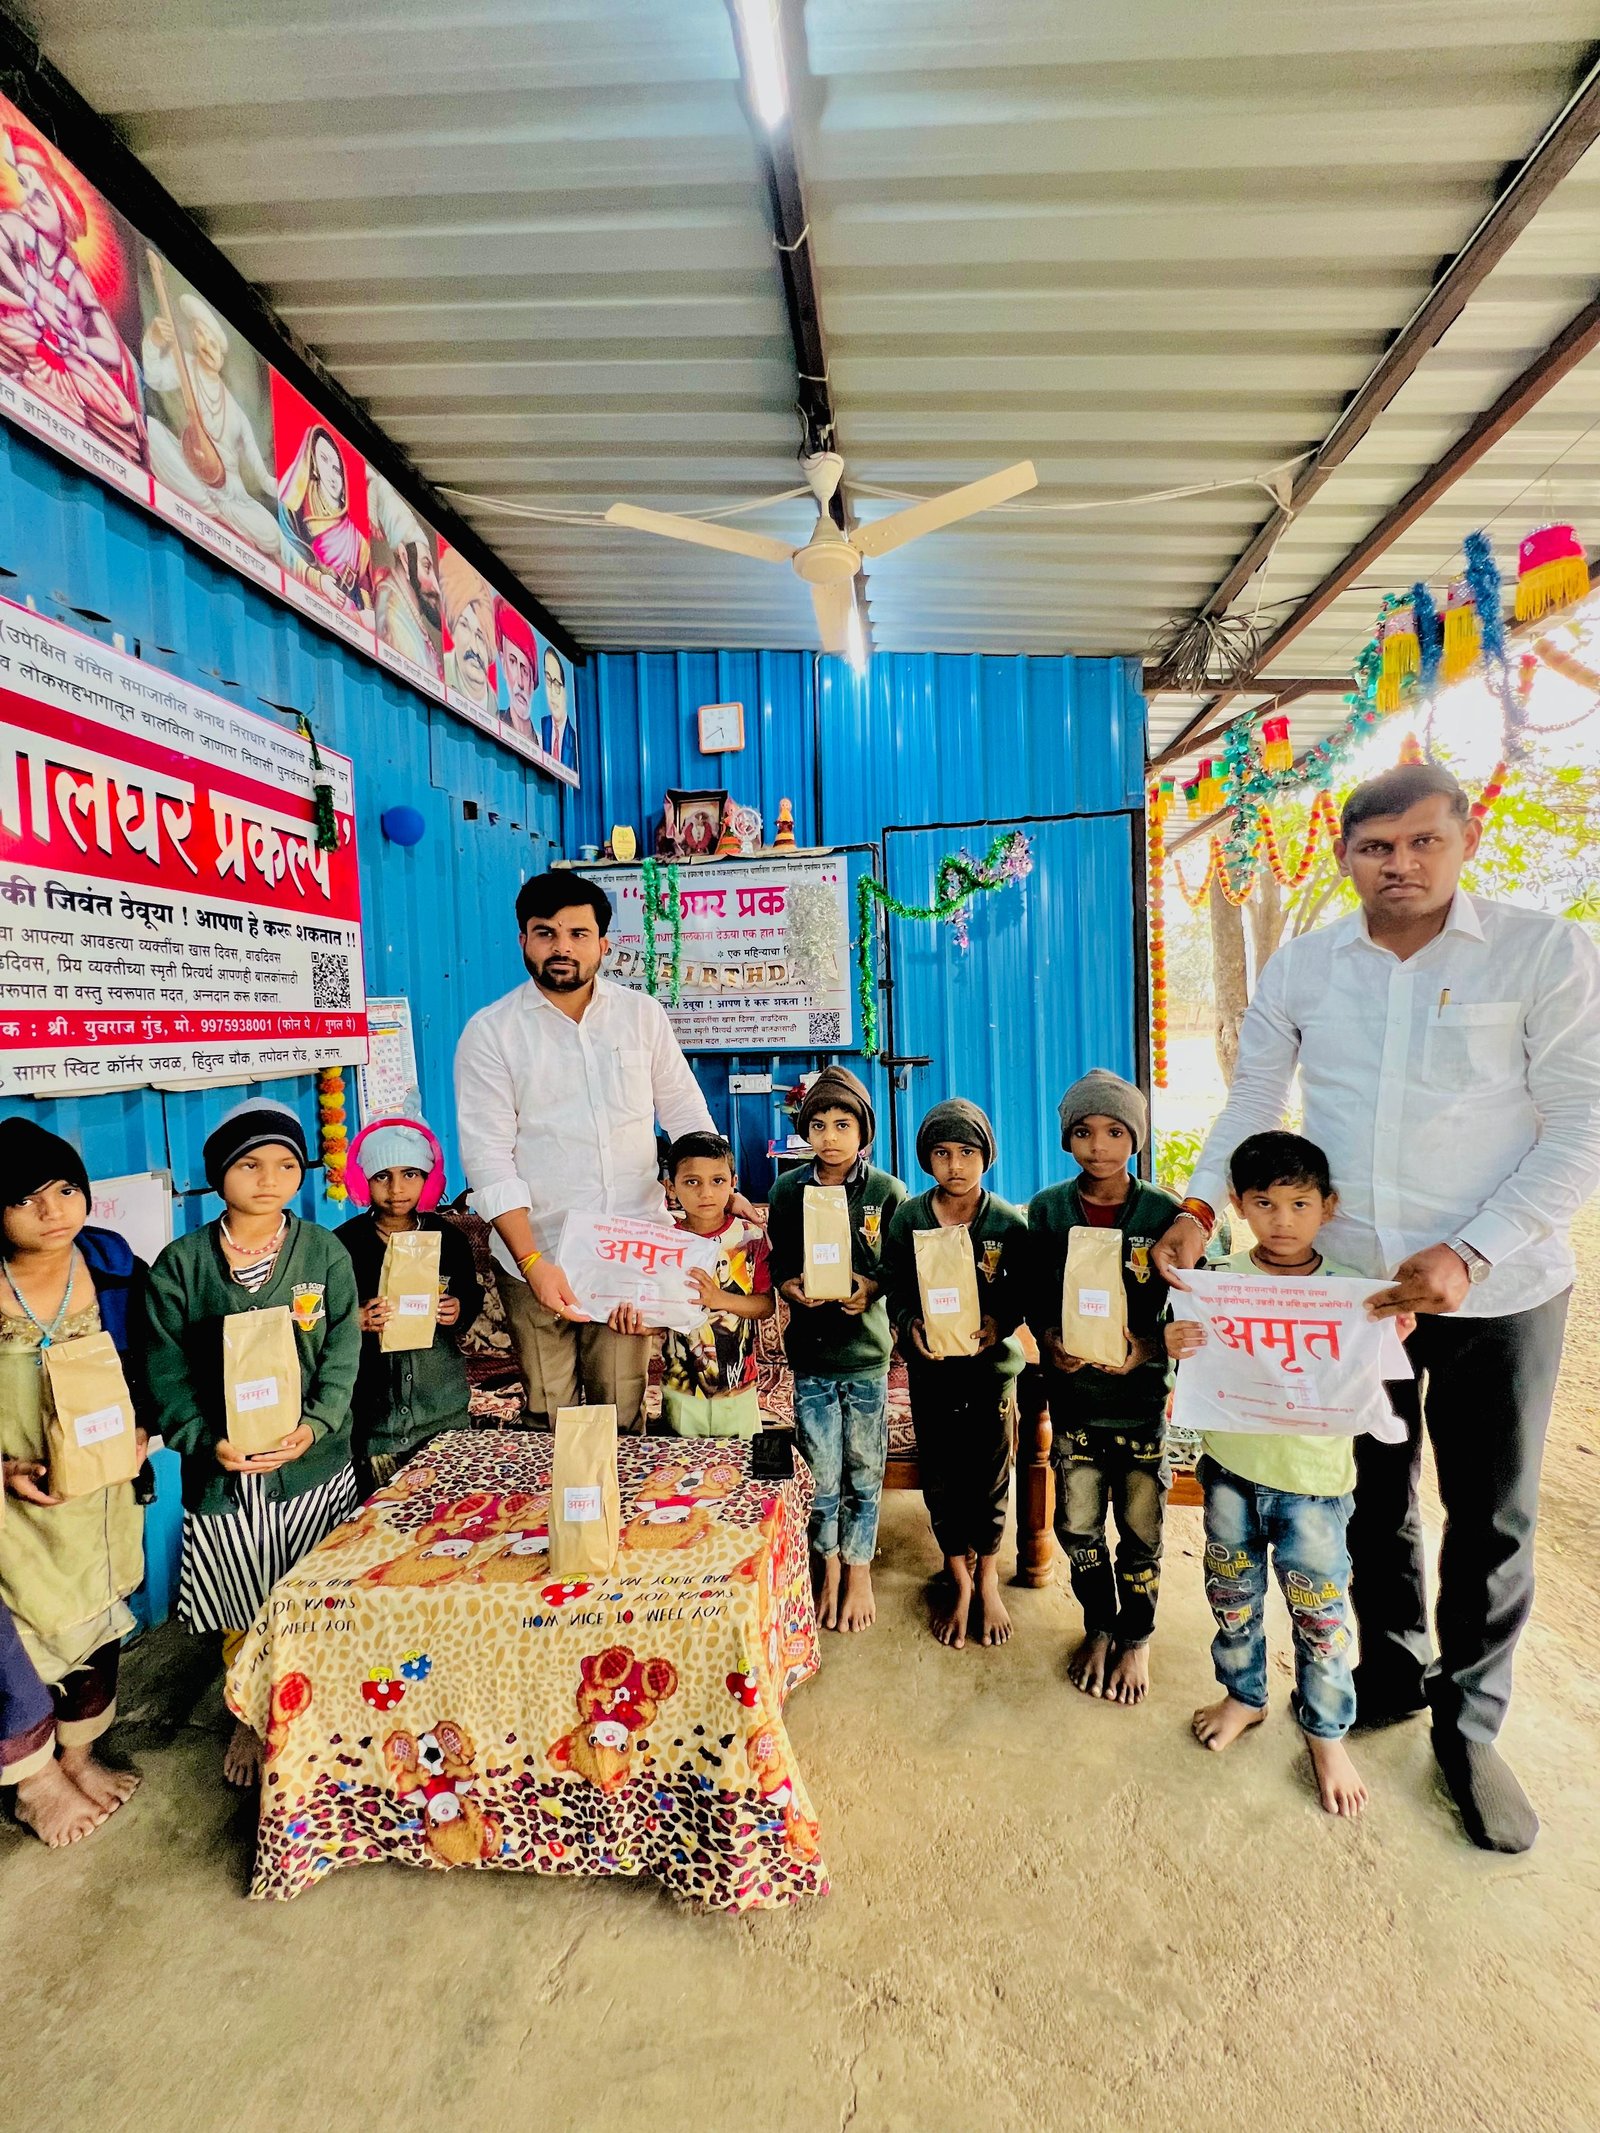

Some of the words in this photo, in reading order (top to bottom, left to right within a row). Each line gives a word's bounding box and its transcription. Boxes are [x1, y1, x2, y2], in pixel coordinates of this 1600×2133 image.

[22, 396, 76, 444] ज्ञानेश्वर
[81, 437, 127, 479] महाराज
[175, 502, 192, 524] संत
[196, 517, 232, 551] तुकाराम
[235, 543, 267, 574] महाराज
[18, 660, 135, 722] लोकसहभागातून
[141, 710, 194, 743] चालविला
[200, 734, 237, 759] जाणारा
[241, 747, 274, 774] निवासी
[73, 651, 113, 684] वंचित
[119, 674, 188, 715] समाजातील
[193, 706, 225, 730] अनाथ
[230, 719, 266, 748] निराधार
[338, 770, 349, 784] घर
[44, 880, 112, 917] जिवंत
[119, 890, 174, 931] ठेवूया
[182, 906, 188, 926] !
[196, 909, 243, 933] आपण
[248, 911, 258, 938] हे
[296, 926, 342, 946] शकतात
[346, 932, 356, 948] !!
[21, 928, 74, 946] आपल्या
[80, 934, 134, 951] आवडत्या
[188, 943, 210, 958] खास
[214, 943, 242, 962] दिवस,
[245, 948, 282, 964] वाढदिवस
[57, 954, 82, 973] प्रिय
[88, 957, 145, 976] व्यक्तीच्या
[151, 961, 177, 981] स्मृती
[217, 967, 251, 983] आपणही
[54, 985, 68, 999] वा
[75, 985, 103, 1005] वस्तु
[107, 987, 155, 1001] स्वरूपात
[160, 989, 188, 1004] मदत,
[193, 989, 230, 1003] अन्नदान
[47, 1016, 76, 1036] श्री.
[83, 1020, 135, 1041] युवराज
[141, 1015, 168, 1040] गुंड,
[174, 1014, 195, 1033] मो.
[200, 1018, 272, 1033] 9975938001
[277, 1015, 301, 1034] (फोन
[325, 1019, 344, 1034] गुगल
[12, 1064, 56, 1081] सागर
[64, 1057, 100, 1078] स्विट
[106, 1055, 143, 1073] कॉर्नर
[149, 1056, 186, 1071] जवळ,
[192, 1051, 224, 1073] हिंदुत्व
[229, 1049, 255, 1066] चौक,
[259, 1047, 289, 1064] तपोवन
[292, 1046, 311, 1062] रोड,
[596, 1239, 689, 1275] अमृत
[1211, 1315, 1342, 1373] अमृत
[239, 1387, 270, 1401] अमृत
[568, 1500, 595, 1512] अमृत
